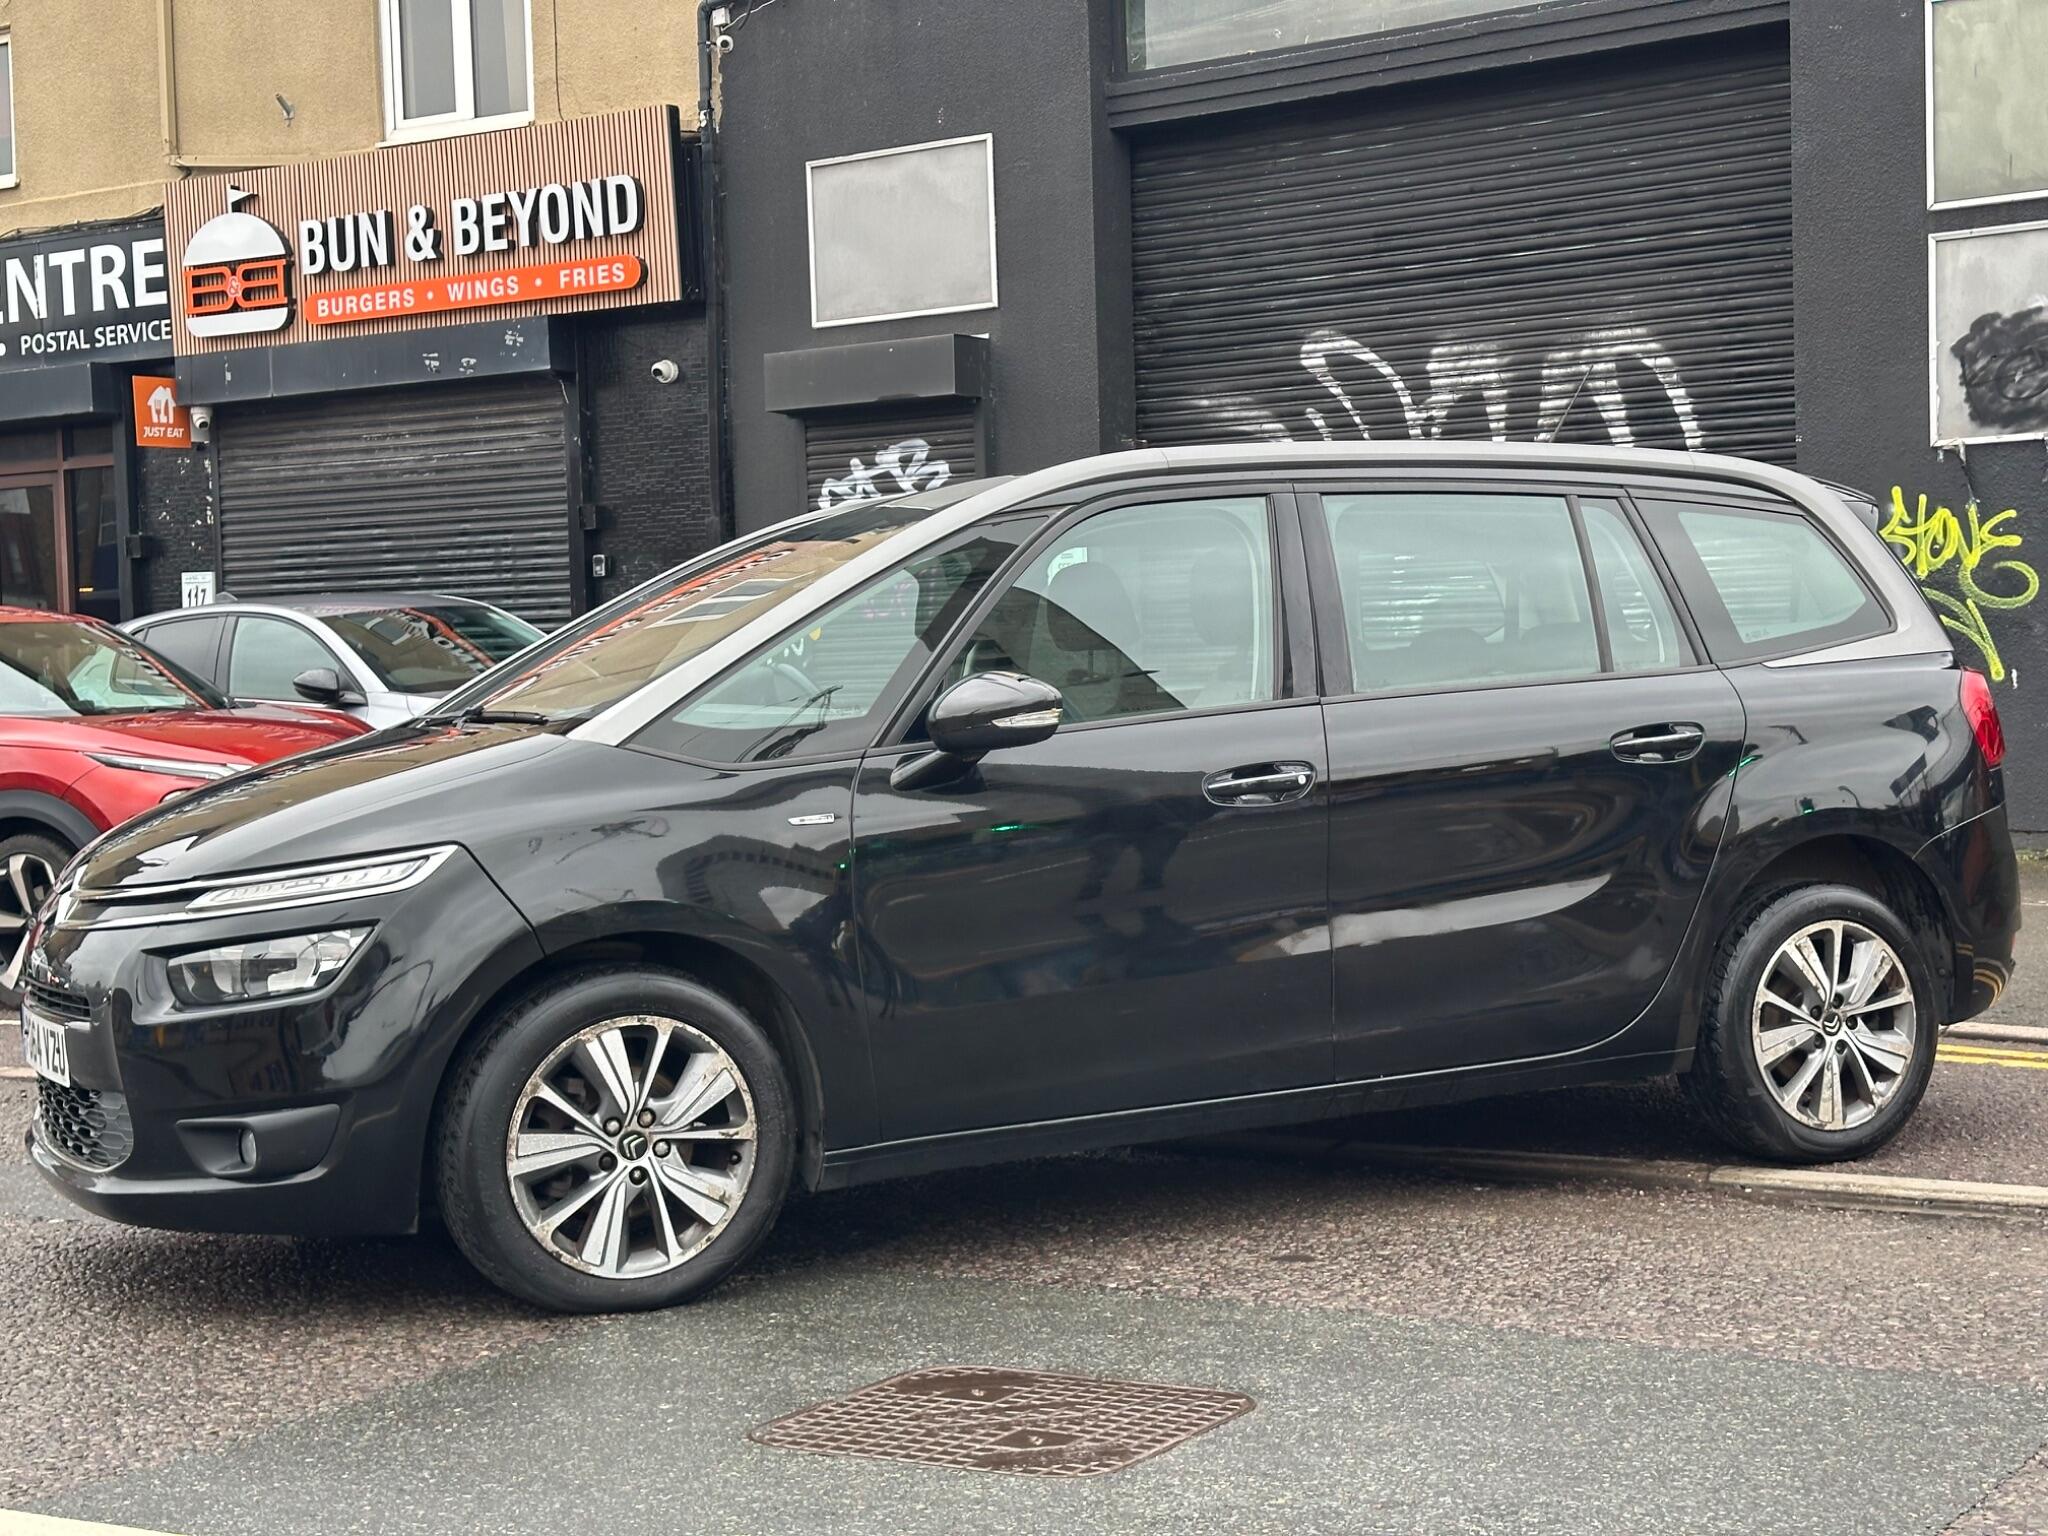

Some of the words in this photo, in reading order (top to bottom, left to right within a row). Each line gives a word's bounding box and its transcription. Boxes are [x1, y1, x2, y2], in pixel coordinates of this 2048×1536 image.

[300, 209, 389, 276] BUN
[405, 203, 437, 262] &
[453, 174, 640, 257] BEYOND
[0, 238, 168, 325] NTRE
[317, 288, 415, 318] BURGERS
[447, 275, 520, 303] WINGS
[559, 262, 626, 289] FRIES
[20, 328, 91, 356] POSTAL
[94, 318, 173, 349] SERVICE
[143, 426, 166, 439] JUST
[167, 427, 185, 438] EAT
